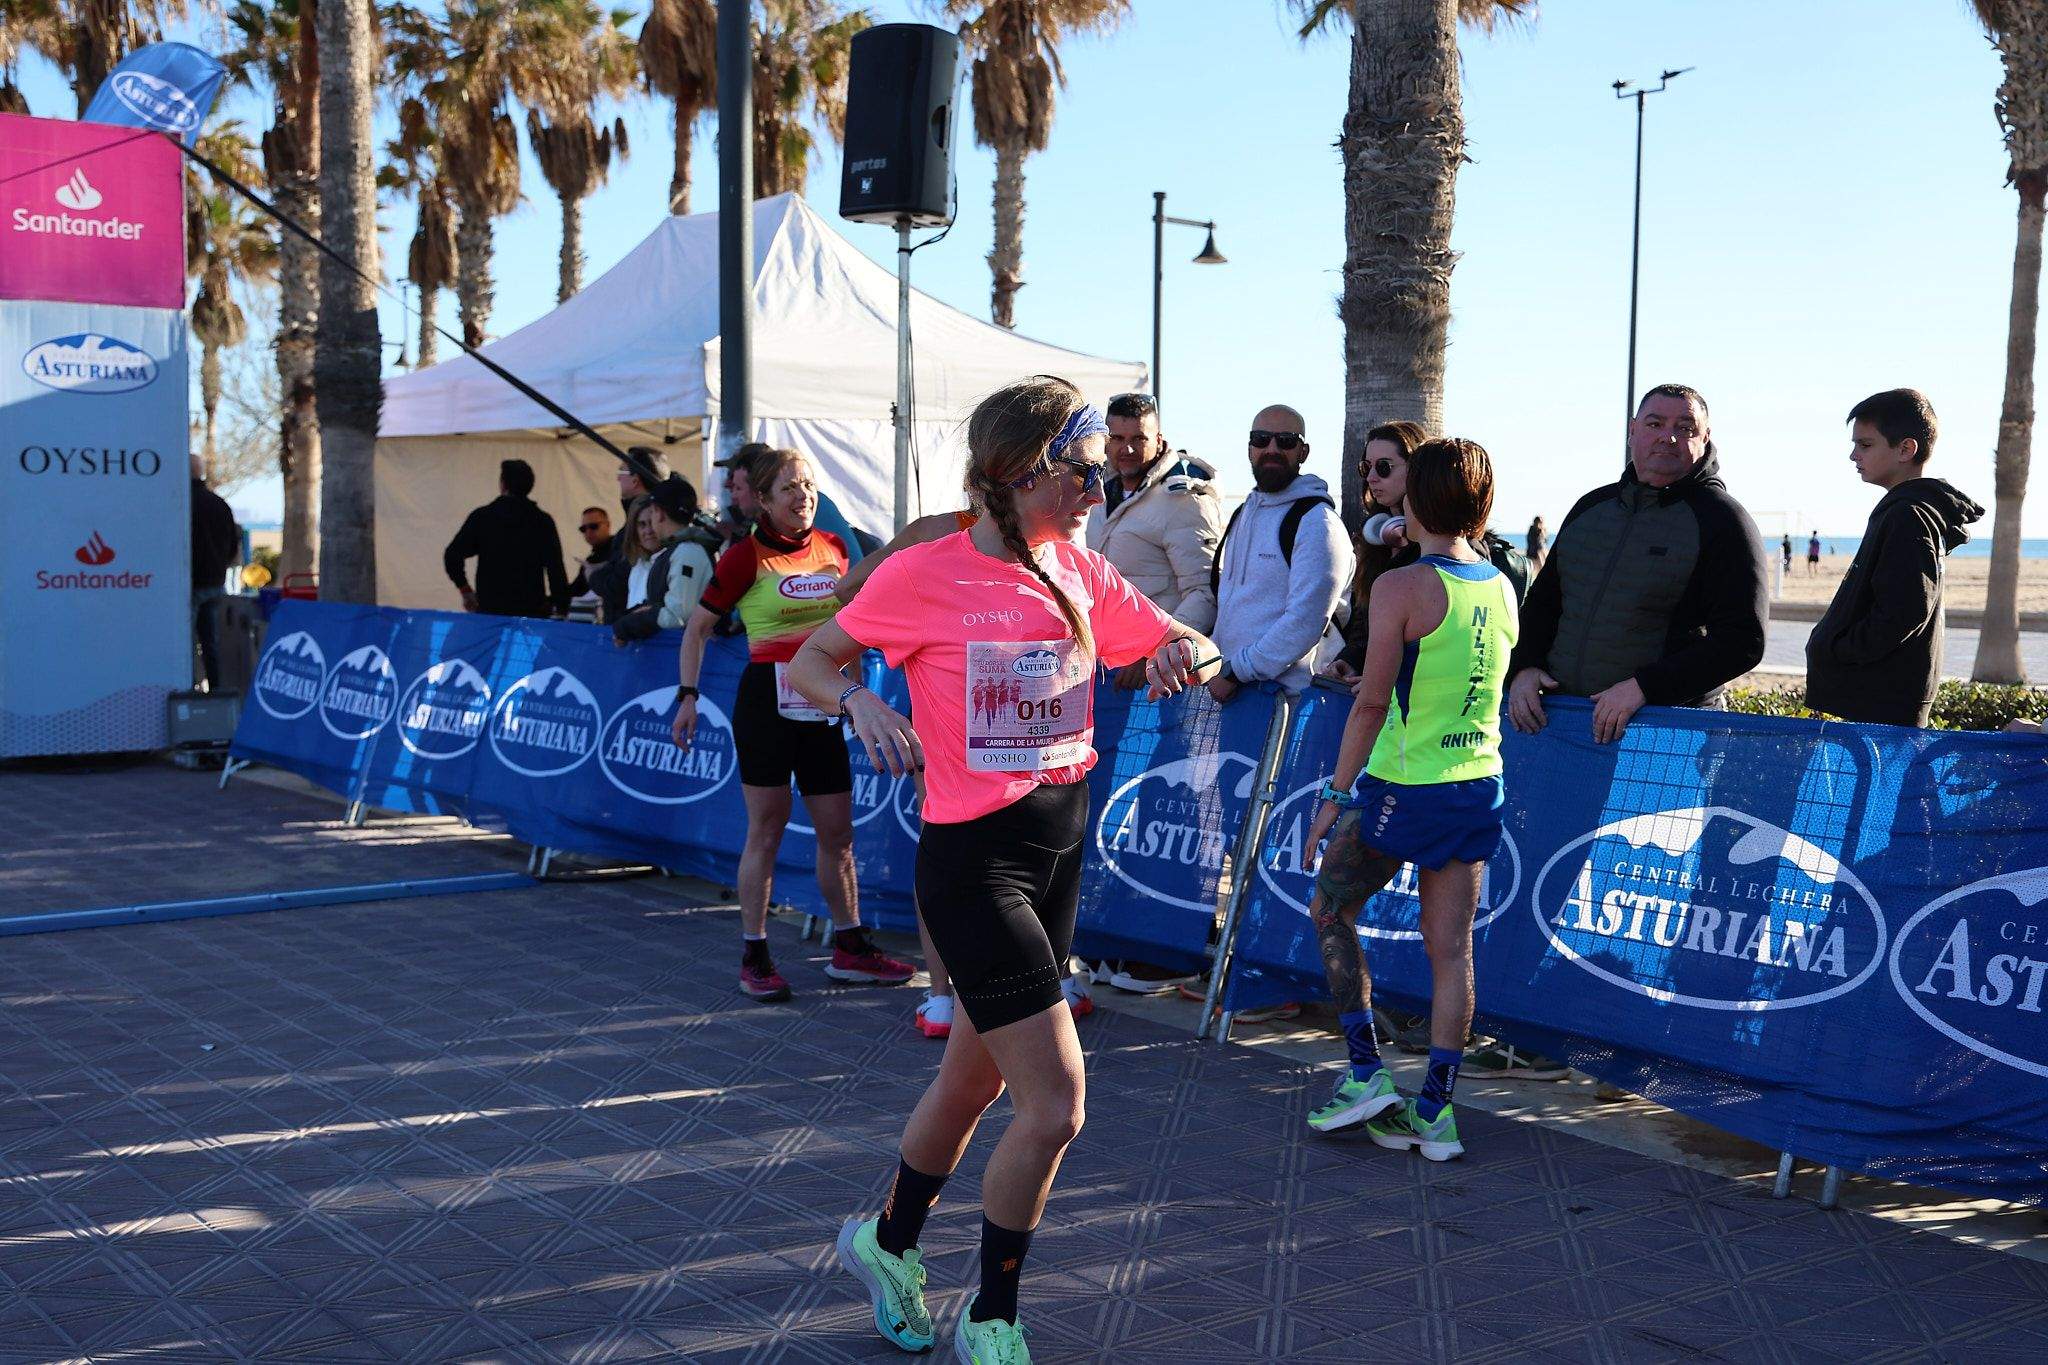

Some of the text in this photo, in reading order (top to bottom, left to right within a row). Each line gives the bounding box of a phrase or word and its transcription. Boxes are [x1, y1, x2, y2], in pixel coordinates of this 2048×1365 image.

[13, 208, 144, 240] Santander
[34, 354, 149, 381] ASTURIANA
[20, 446, 161, 476] OYSHO
[36, 570, 153, 589] Santander
[786, 580, 836, 593] Serrano
[963, 609, 1023, 626] OYSHO
[979, 665, 1006, 674] SUMA
[1016, 660, 1059, 672] ASTURIANA
[1017, 698, 1062, 721] 016
[495, 701, 588, 755] ASTURIANA
[1027, 725, 1050, 735] 4339
[985, 739, 1015, 747] CARRERA
[1036, 736, 1055, 746] MUJER
[1441, 731, 1484, 748] ANITA
[605, 719, 722, 781] ASTURIANA
[983, 753, 1027, 764] OYSHO
[1613, 861, 1848, 915] CENTRAL LECHERA
[1550, 858, 1848, 978] ASTURIANA
